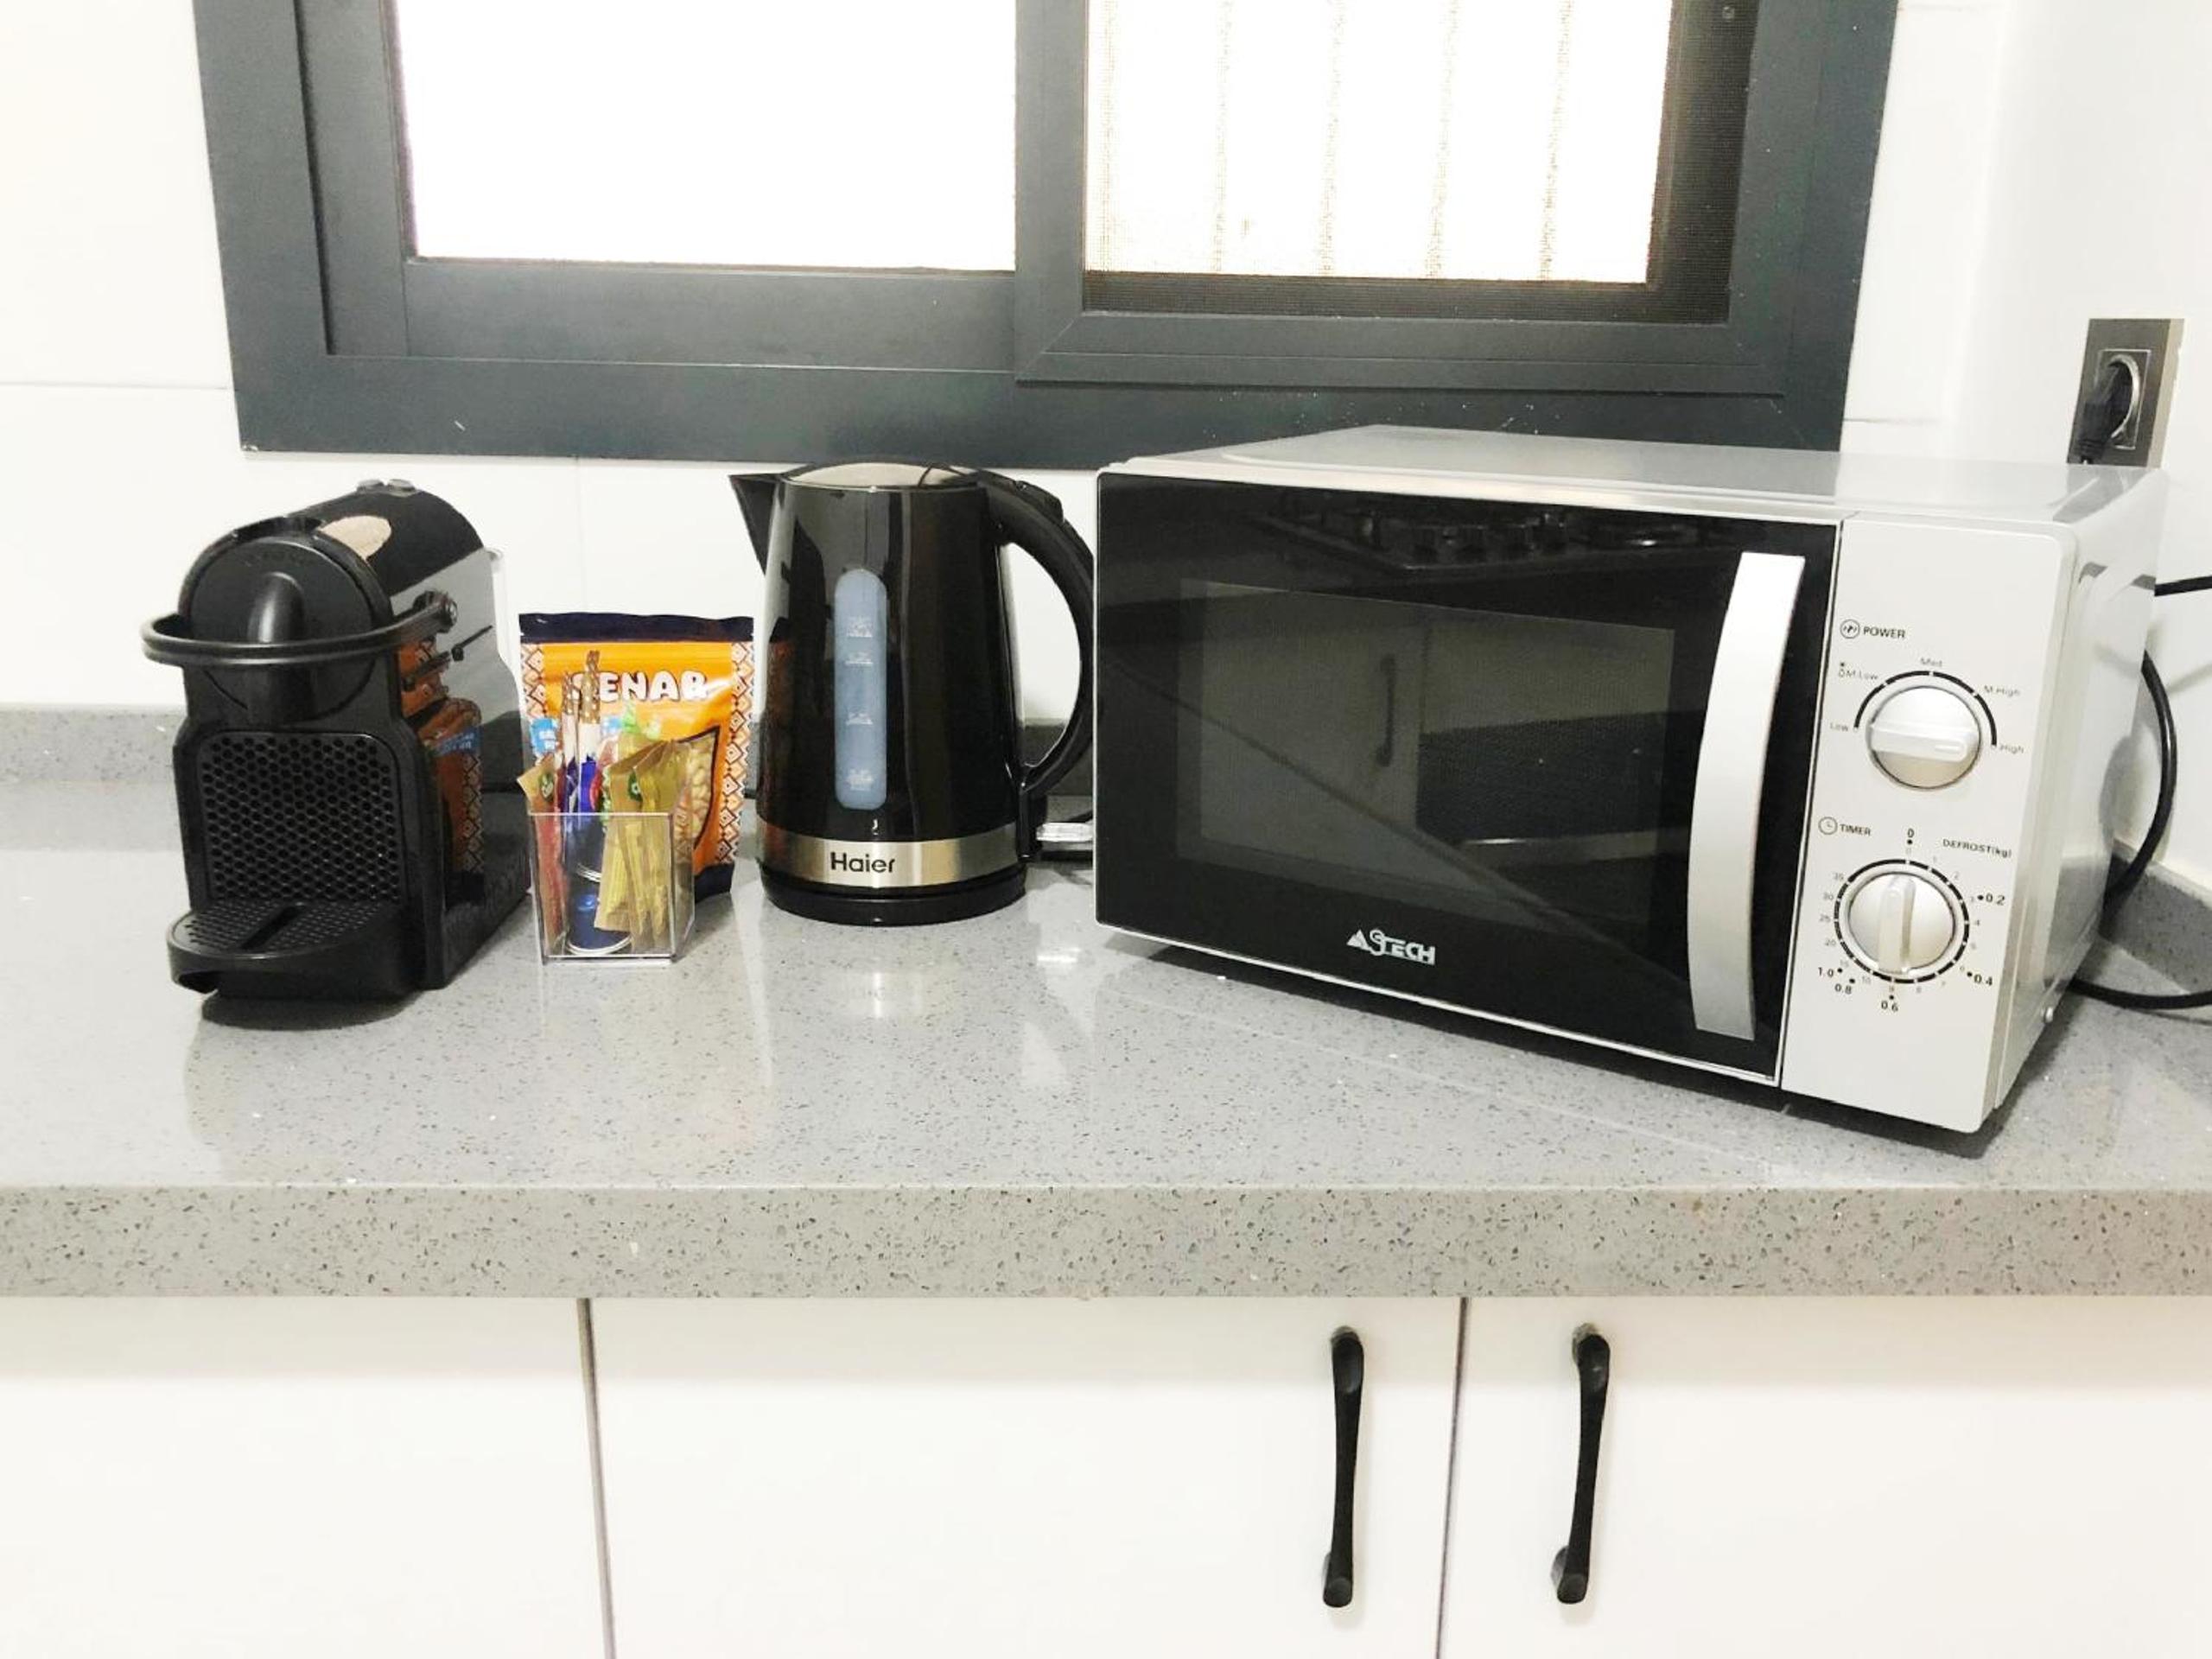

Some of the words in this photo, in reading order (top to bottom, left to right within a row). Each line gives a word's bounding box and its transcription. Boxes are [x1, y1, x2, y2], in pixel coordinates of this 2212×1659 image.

[1863, 626, 1906, 639] POWER
[1840, 823, 1872, 836] TIMER
[1907, 828, 1915, 839] 0
[830, 851, 896, 874] Haier
